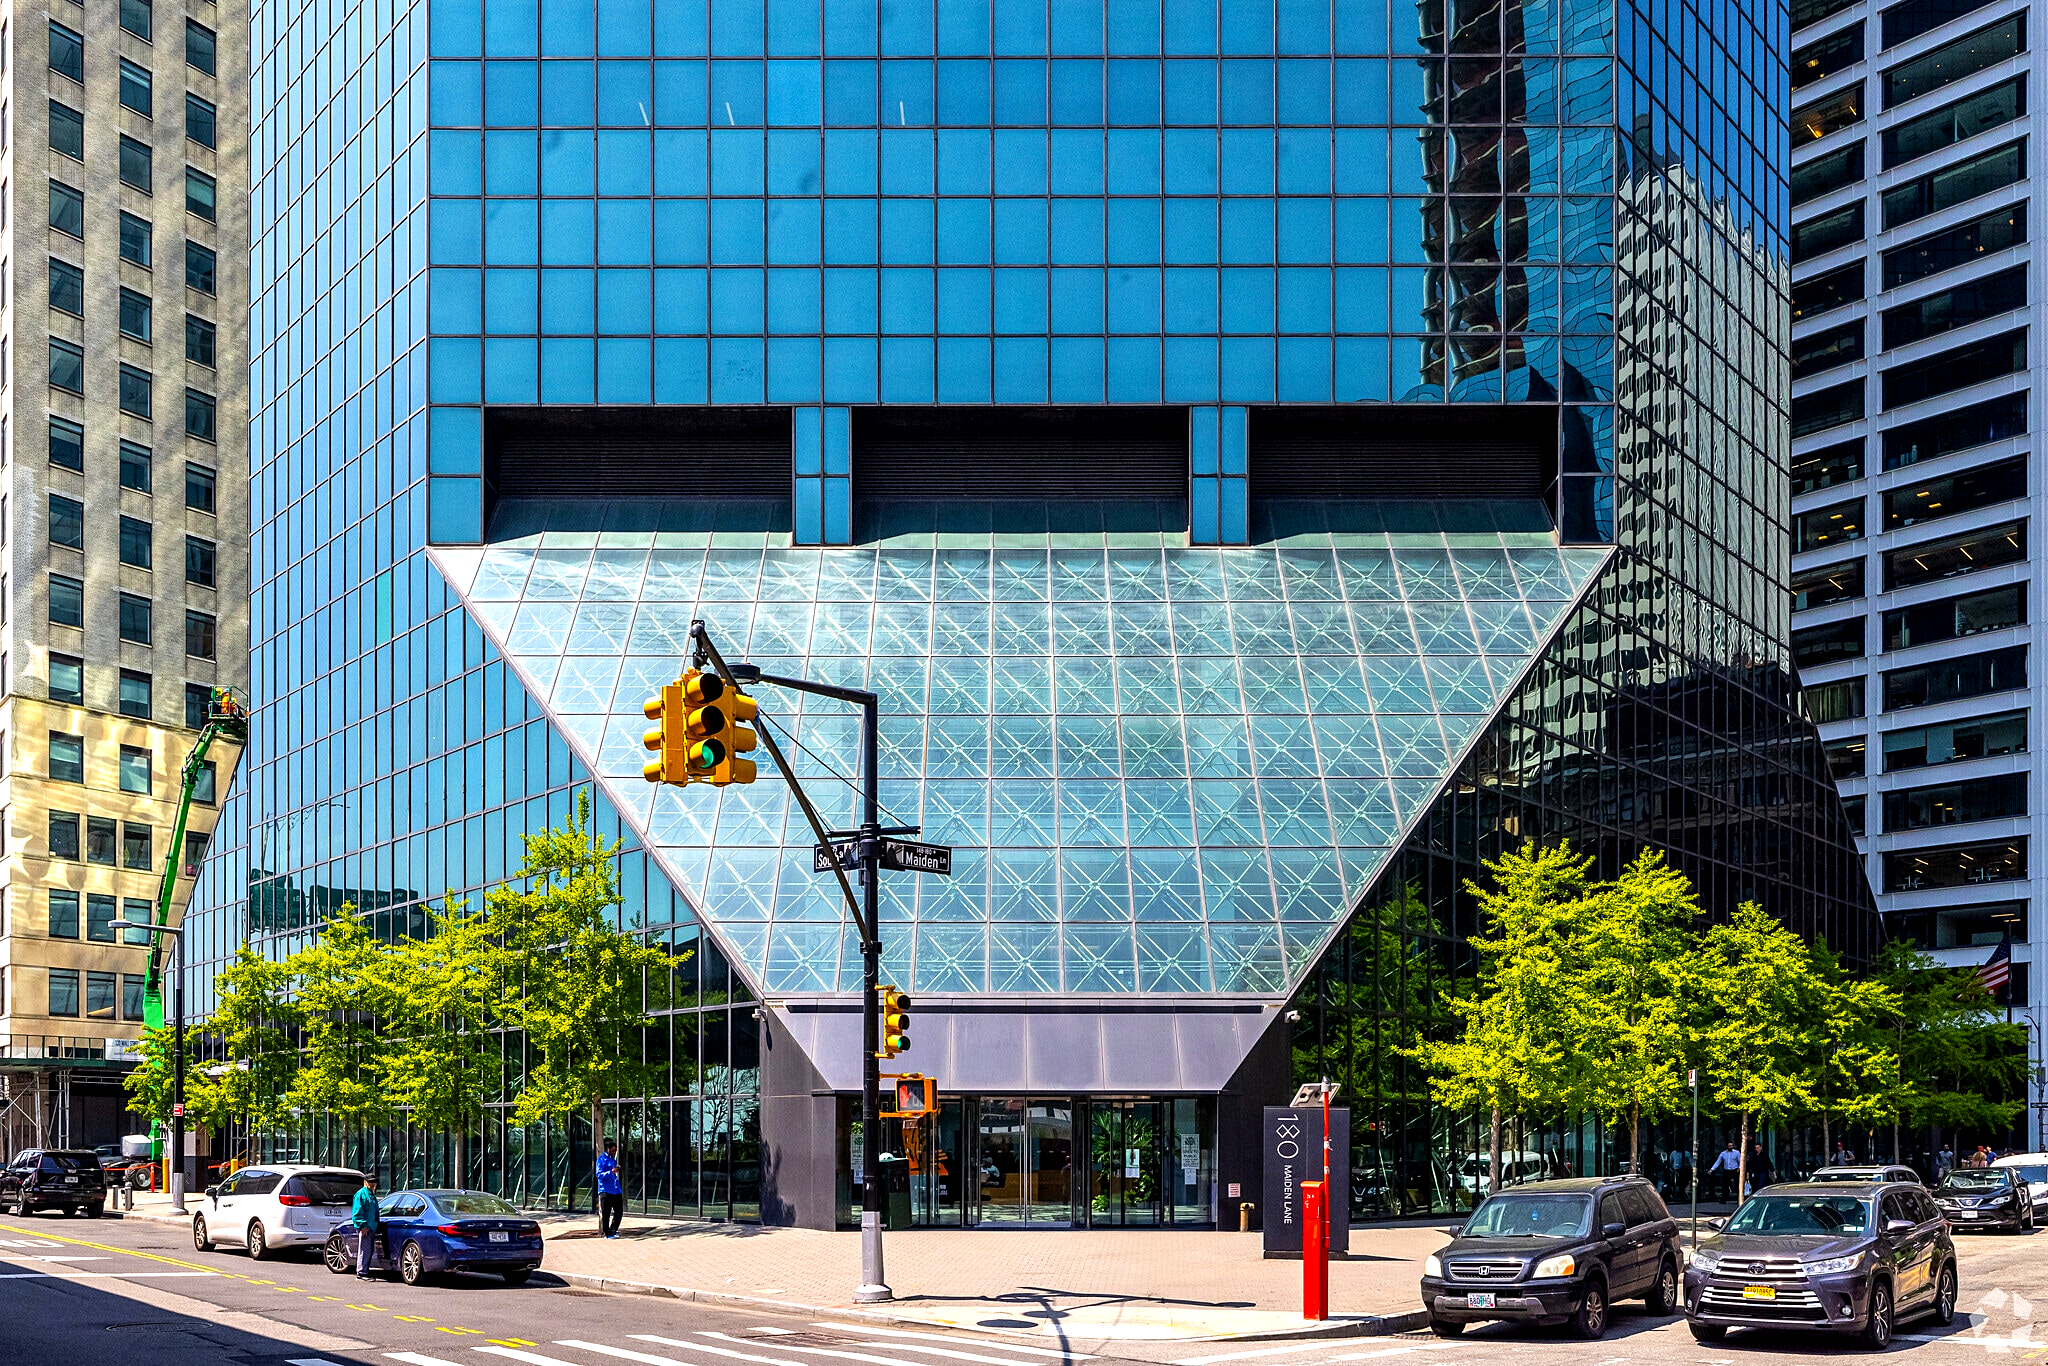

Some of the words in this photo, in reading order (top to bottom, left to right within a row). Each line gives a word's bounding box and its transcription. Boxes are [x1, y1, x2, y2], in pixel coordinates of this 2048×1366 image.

[905, 851, 939, 869] Maiden
[940, 856, 947, 864] Ln
[1276, 1113, 1300, 1159] 180
[1283, 1164, 1293, 1200] MAIDEN
[1283, 1201, 1293, 1224] LANE
